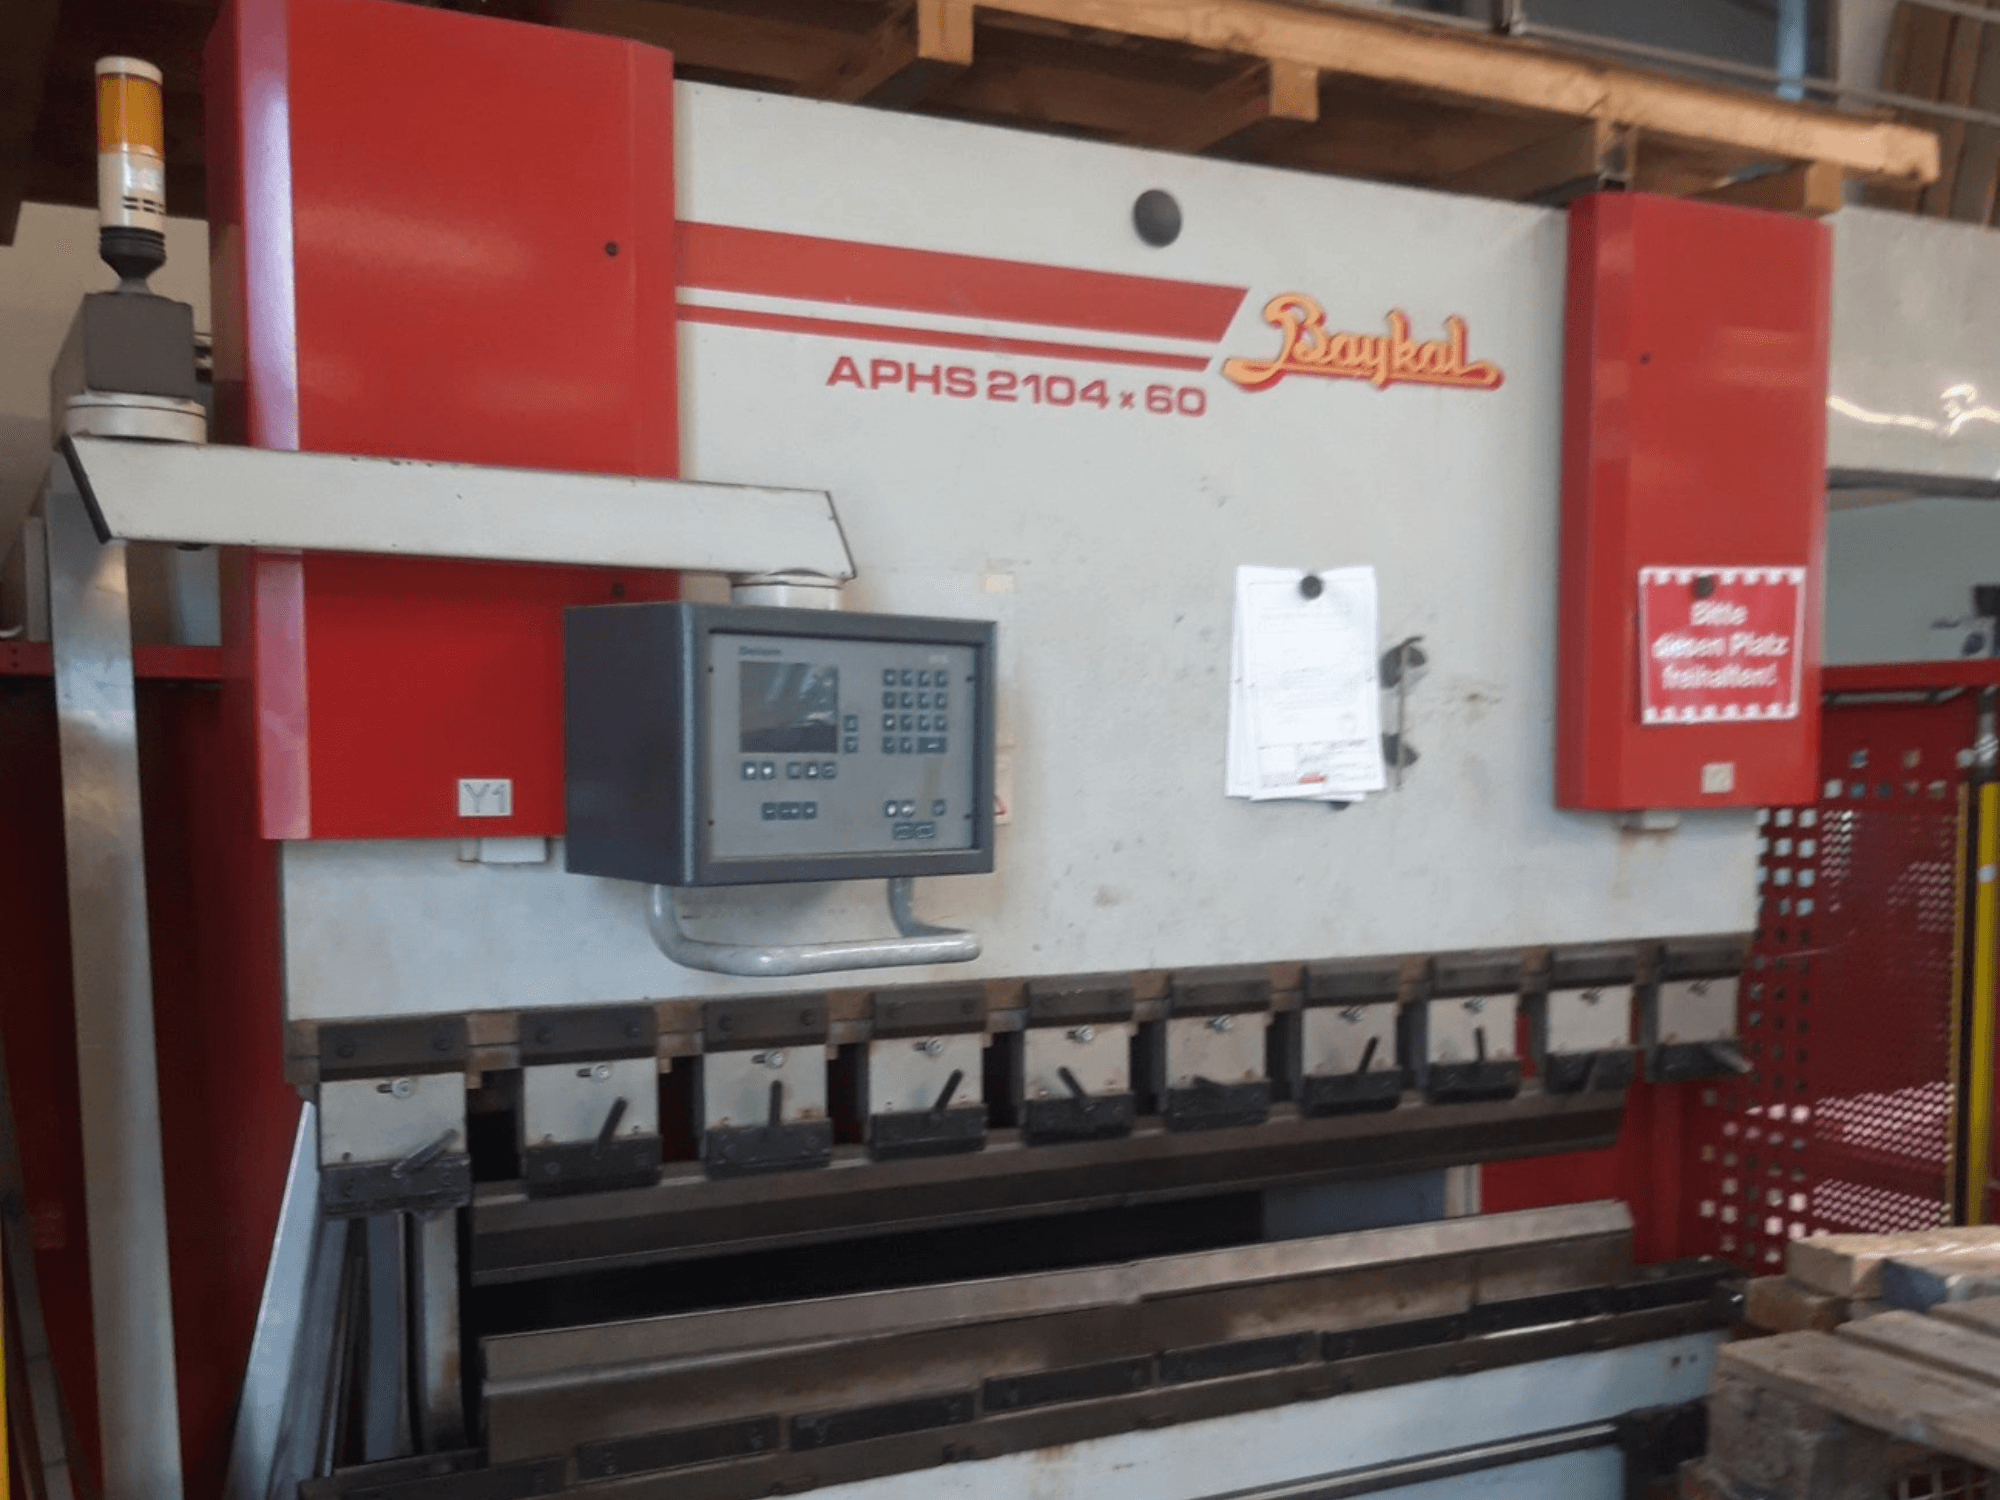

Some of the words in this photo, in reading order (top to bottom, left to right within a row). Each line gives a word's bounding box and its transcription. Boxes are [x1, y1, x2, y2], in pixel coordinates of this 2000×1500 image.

[1223, 292, 1505, 391] Baykal
[827, 355, 978, 398] APHS
[987, 371, 1110, 410] 2104
[1145, 384, 1206, 417] 60
[464, 783, 507, 813] Y1
